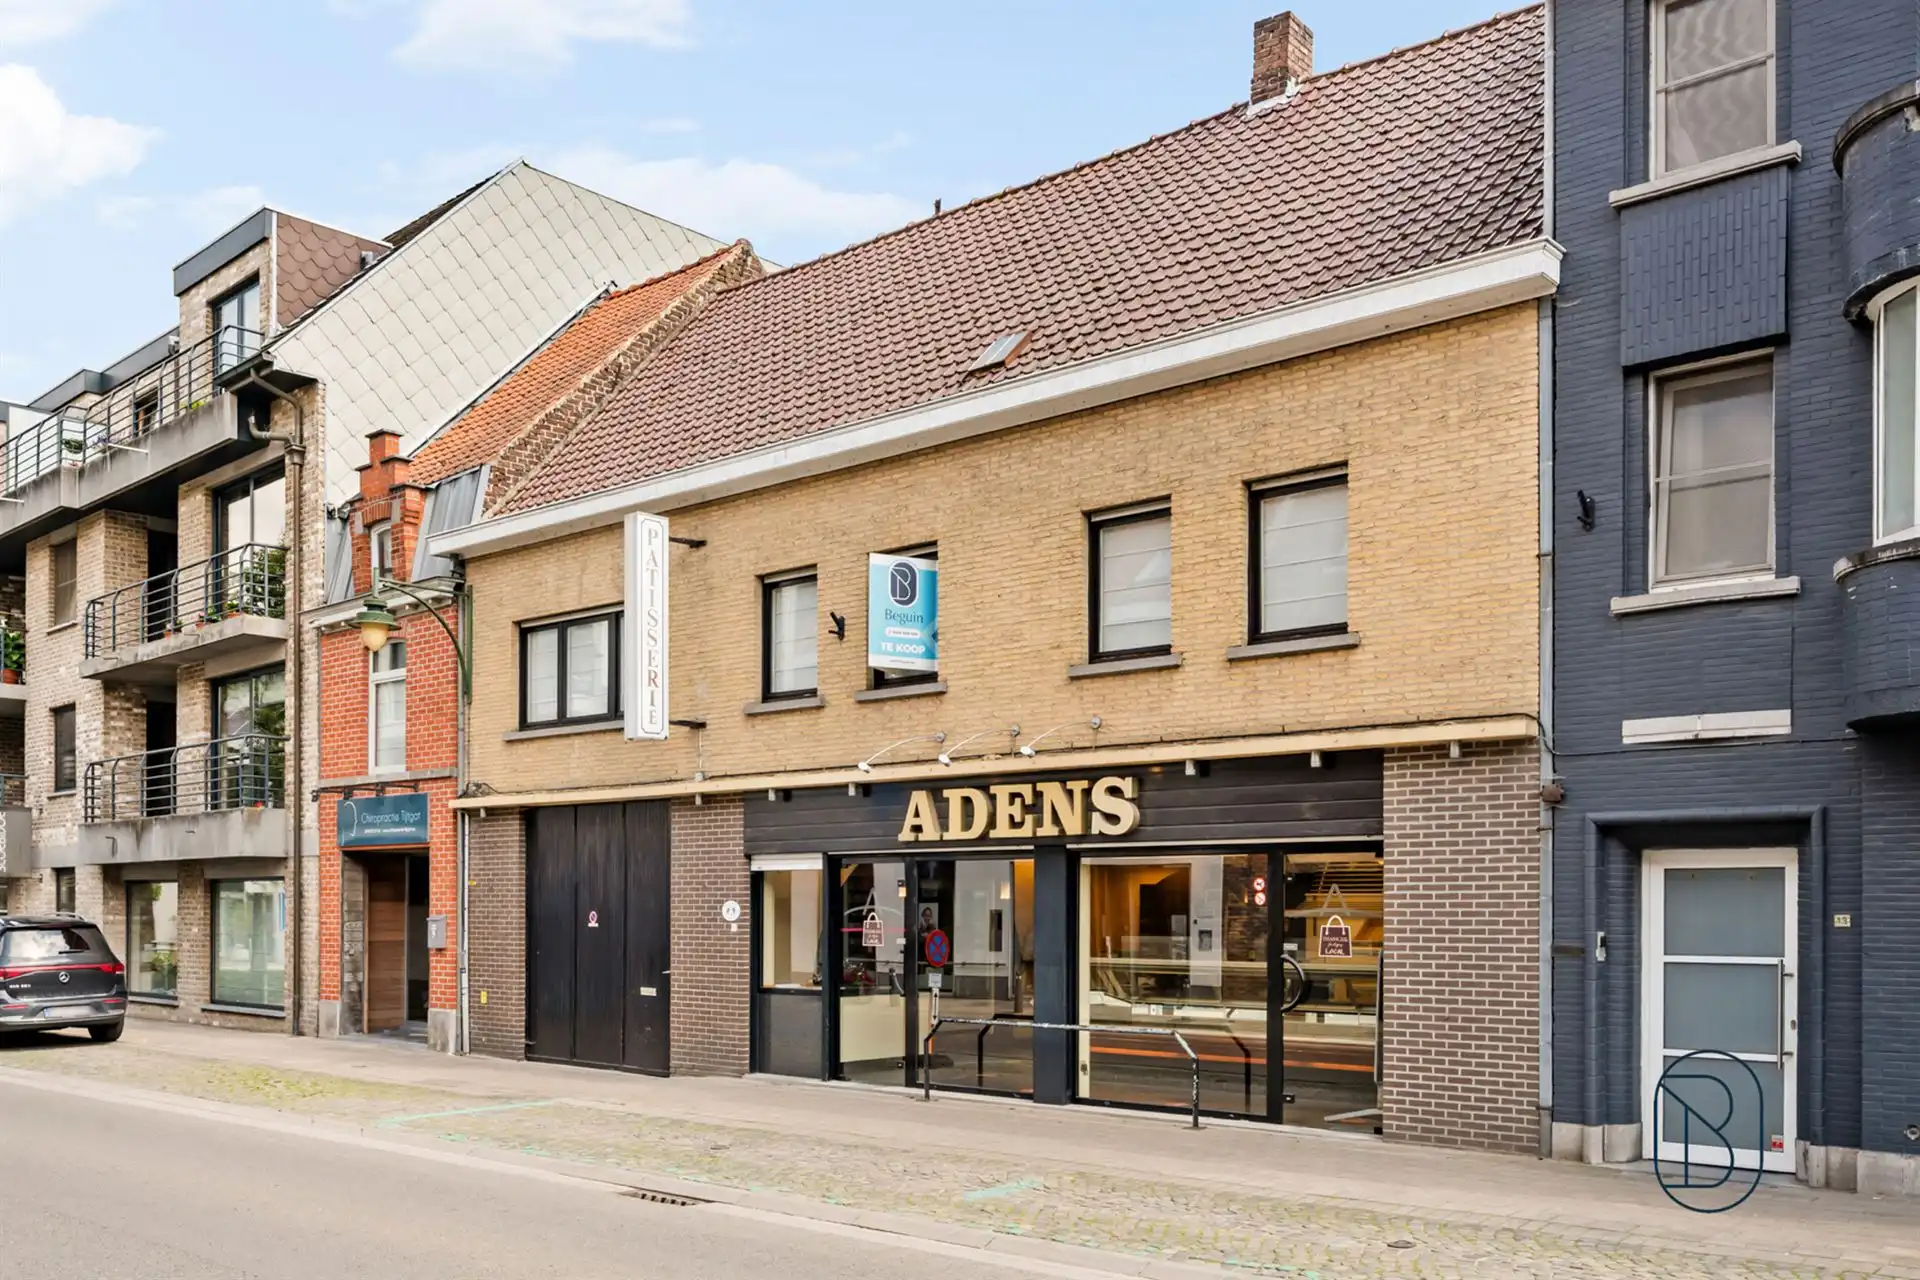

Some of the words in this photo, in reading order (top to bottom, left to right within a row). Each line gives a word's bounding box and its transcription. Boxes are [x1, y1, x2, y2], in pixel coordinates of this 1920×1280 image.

[646, 527, 659, 726] PATISSERIE
[884, 608, 924, 625] Beguin
[881, 642, 894, 652] TE
[896, 643, 926, 654] KOOP
[898, 776, 1140, 842] ADENS
